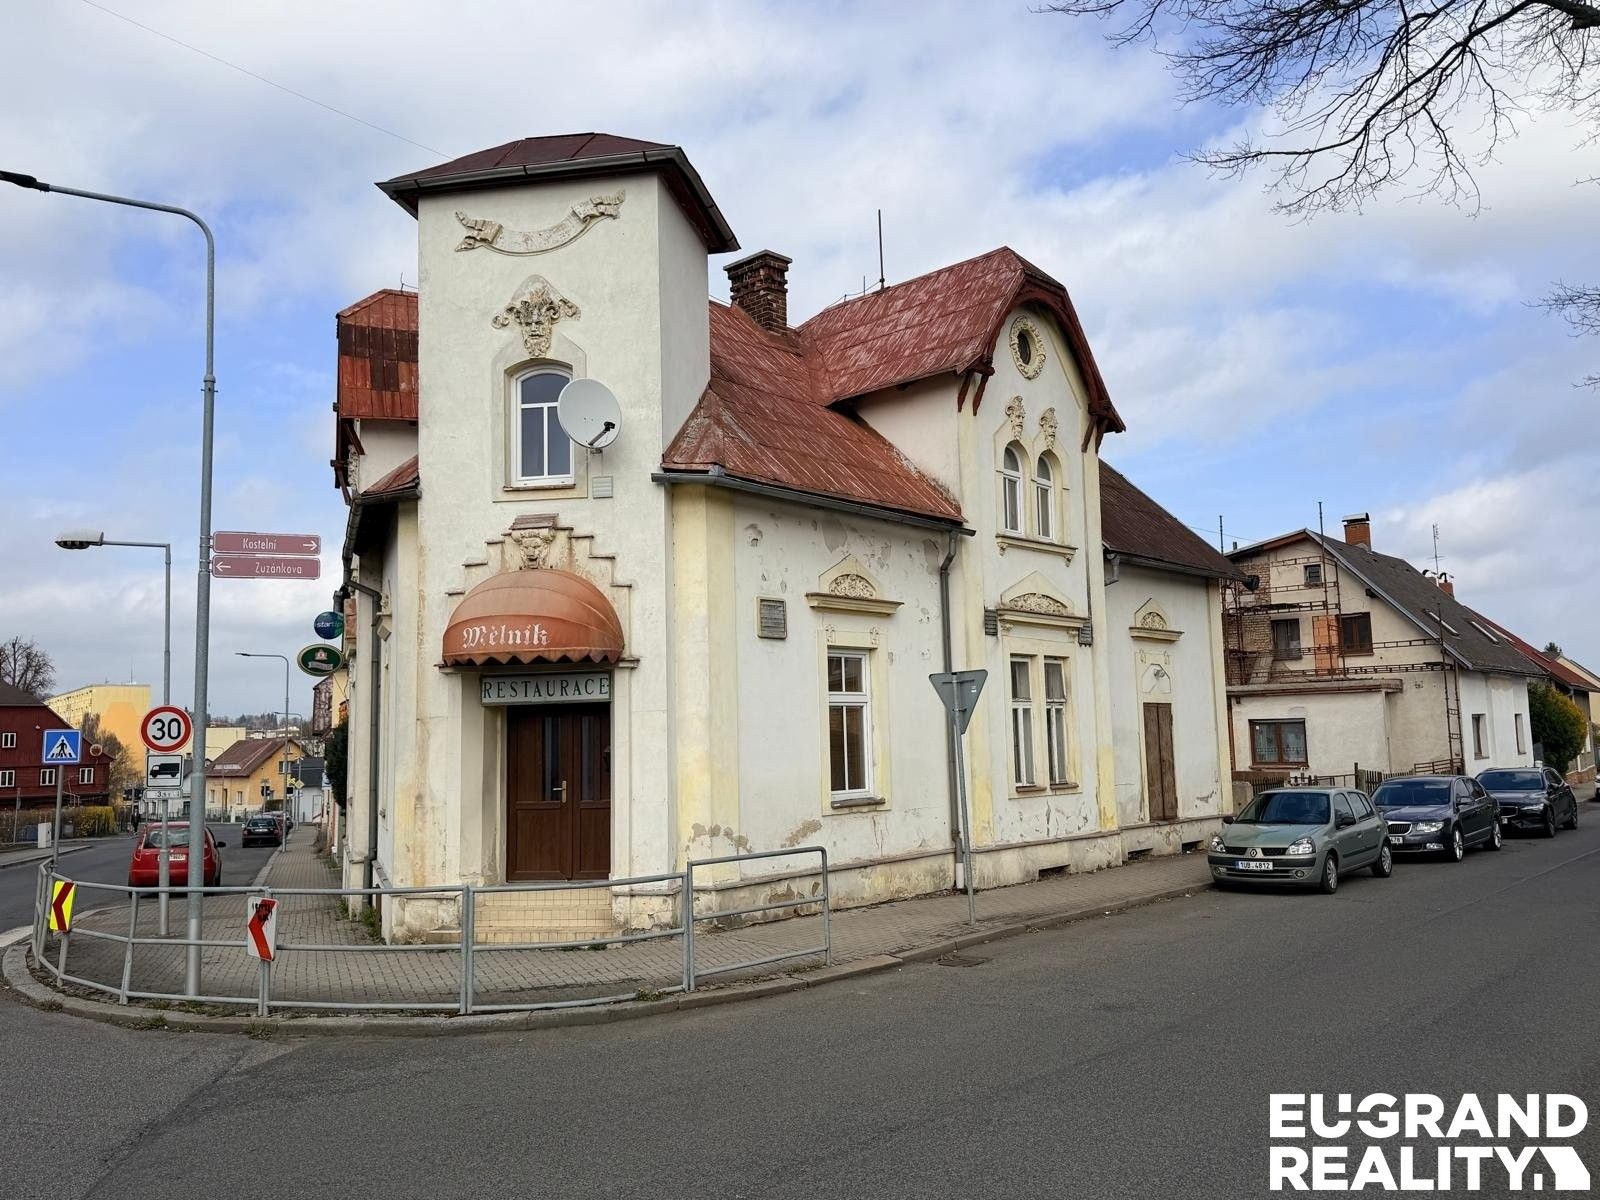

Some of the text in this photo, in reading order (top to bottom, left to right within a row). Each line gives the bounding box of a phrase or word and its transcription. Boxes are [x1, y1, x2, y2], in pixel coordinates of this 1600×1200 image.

[242, 538, 277, 550] Kostelní
[255, 561, 302, 574] Zuzánkova
[483, 677, 609, 699] RESTAURACE
[152, 717, 181, 741] 30
